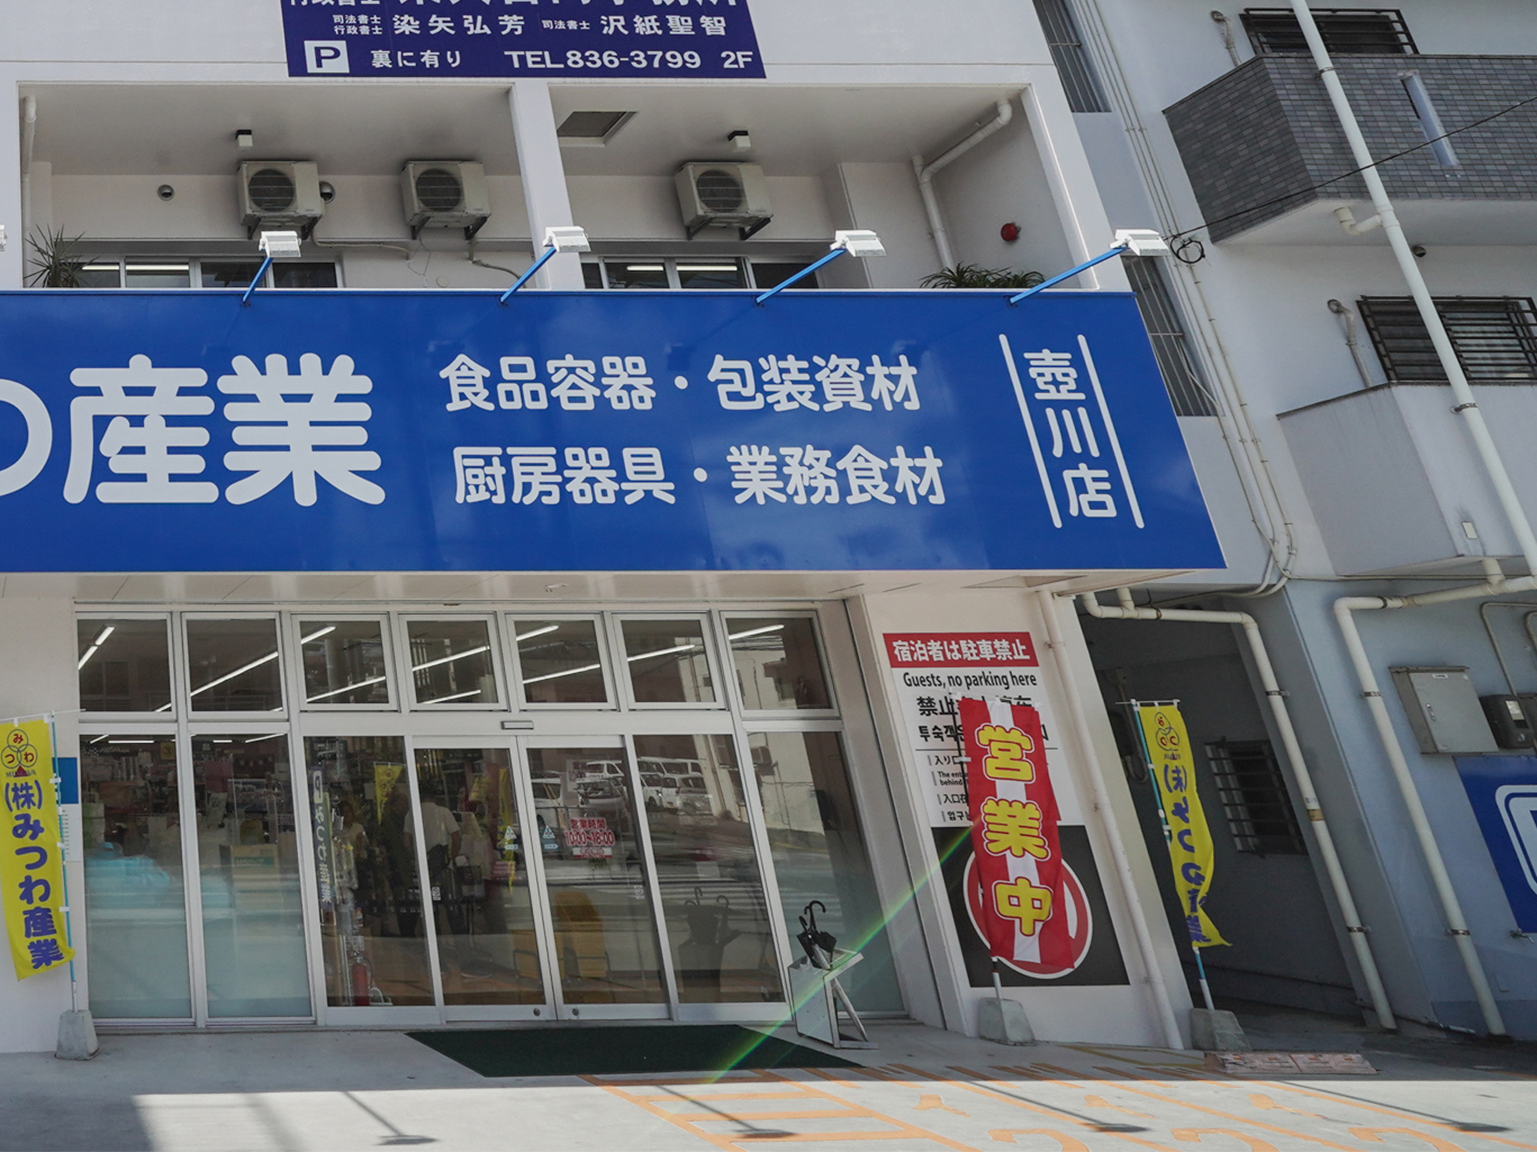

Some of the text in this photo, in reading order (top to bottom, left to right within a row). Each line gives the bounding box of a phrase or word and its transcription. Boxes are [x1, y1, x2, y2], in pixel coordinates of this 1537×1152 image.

[332, 14, 381, 25] 司法書士
[334, 25, 383, 35] 行政書士
[370, 50, 461, 68] 裏に有り
[720, 51, 754, 69] 2F
[892, 639, 1030, 662] 宿泊者は駐車禁止
[903, 671, 1037, 690] Guests, no parking here
[976, 725, 1052, 936] 営業中
